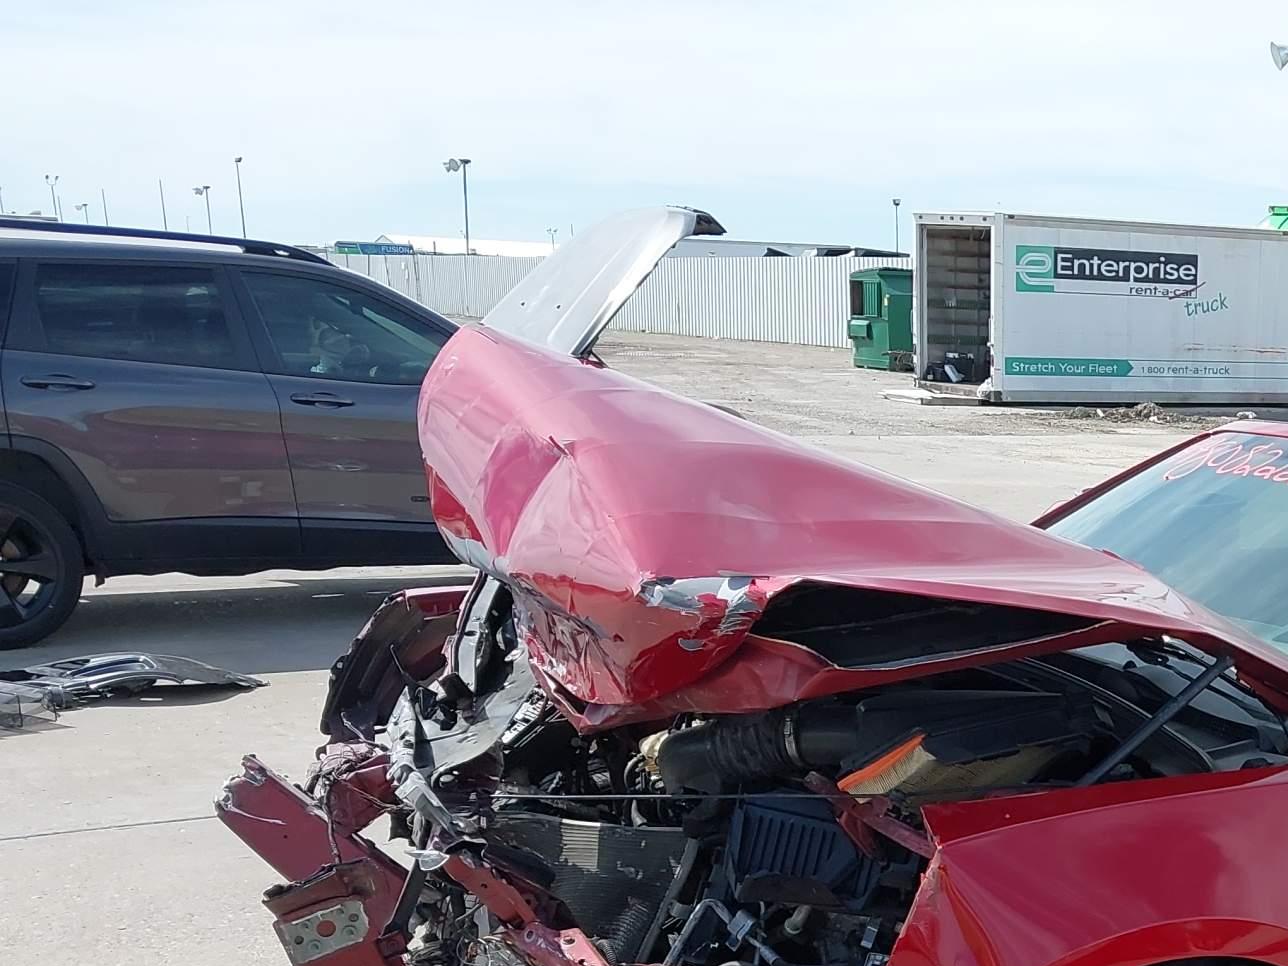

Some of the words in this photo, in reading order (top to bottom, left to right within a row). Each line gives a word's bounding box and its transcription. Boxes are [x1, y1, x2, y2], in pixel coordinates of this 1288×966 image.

[1057, 254, 1196, 282] Enterprise
[1183, 292, 1229, 317] truck
[1011, 361, 1056, 373] Stretch
[1058, 363, 1087, 373] Your
[1088, 363, 1118, 374] Fleet
[1147, 366, 1165, 374] 800
[1166, 365, 1231, 376] rent-a-truck
